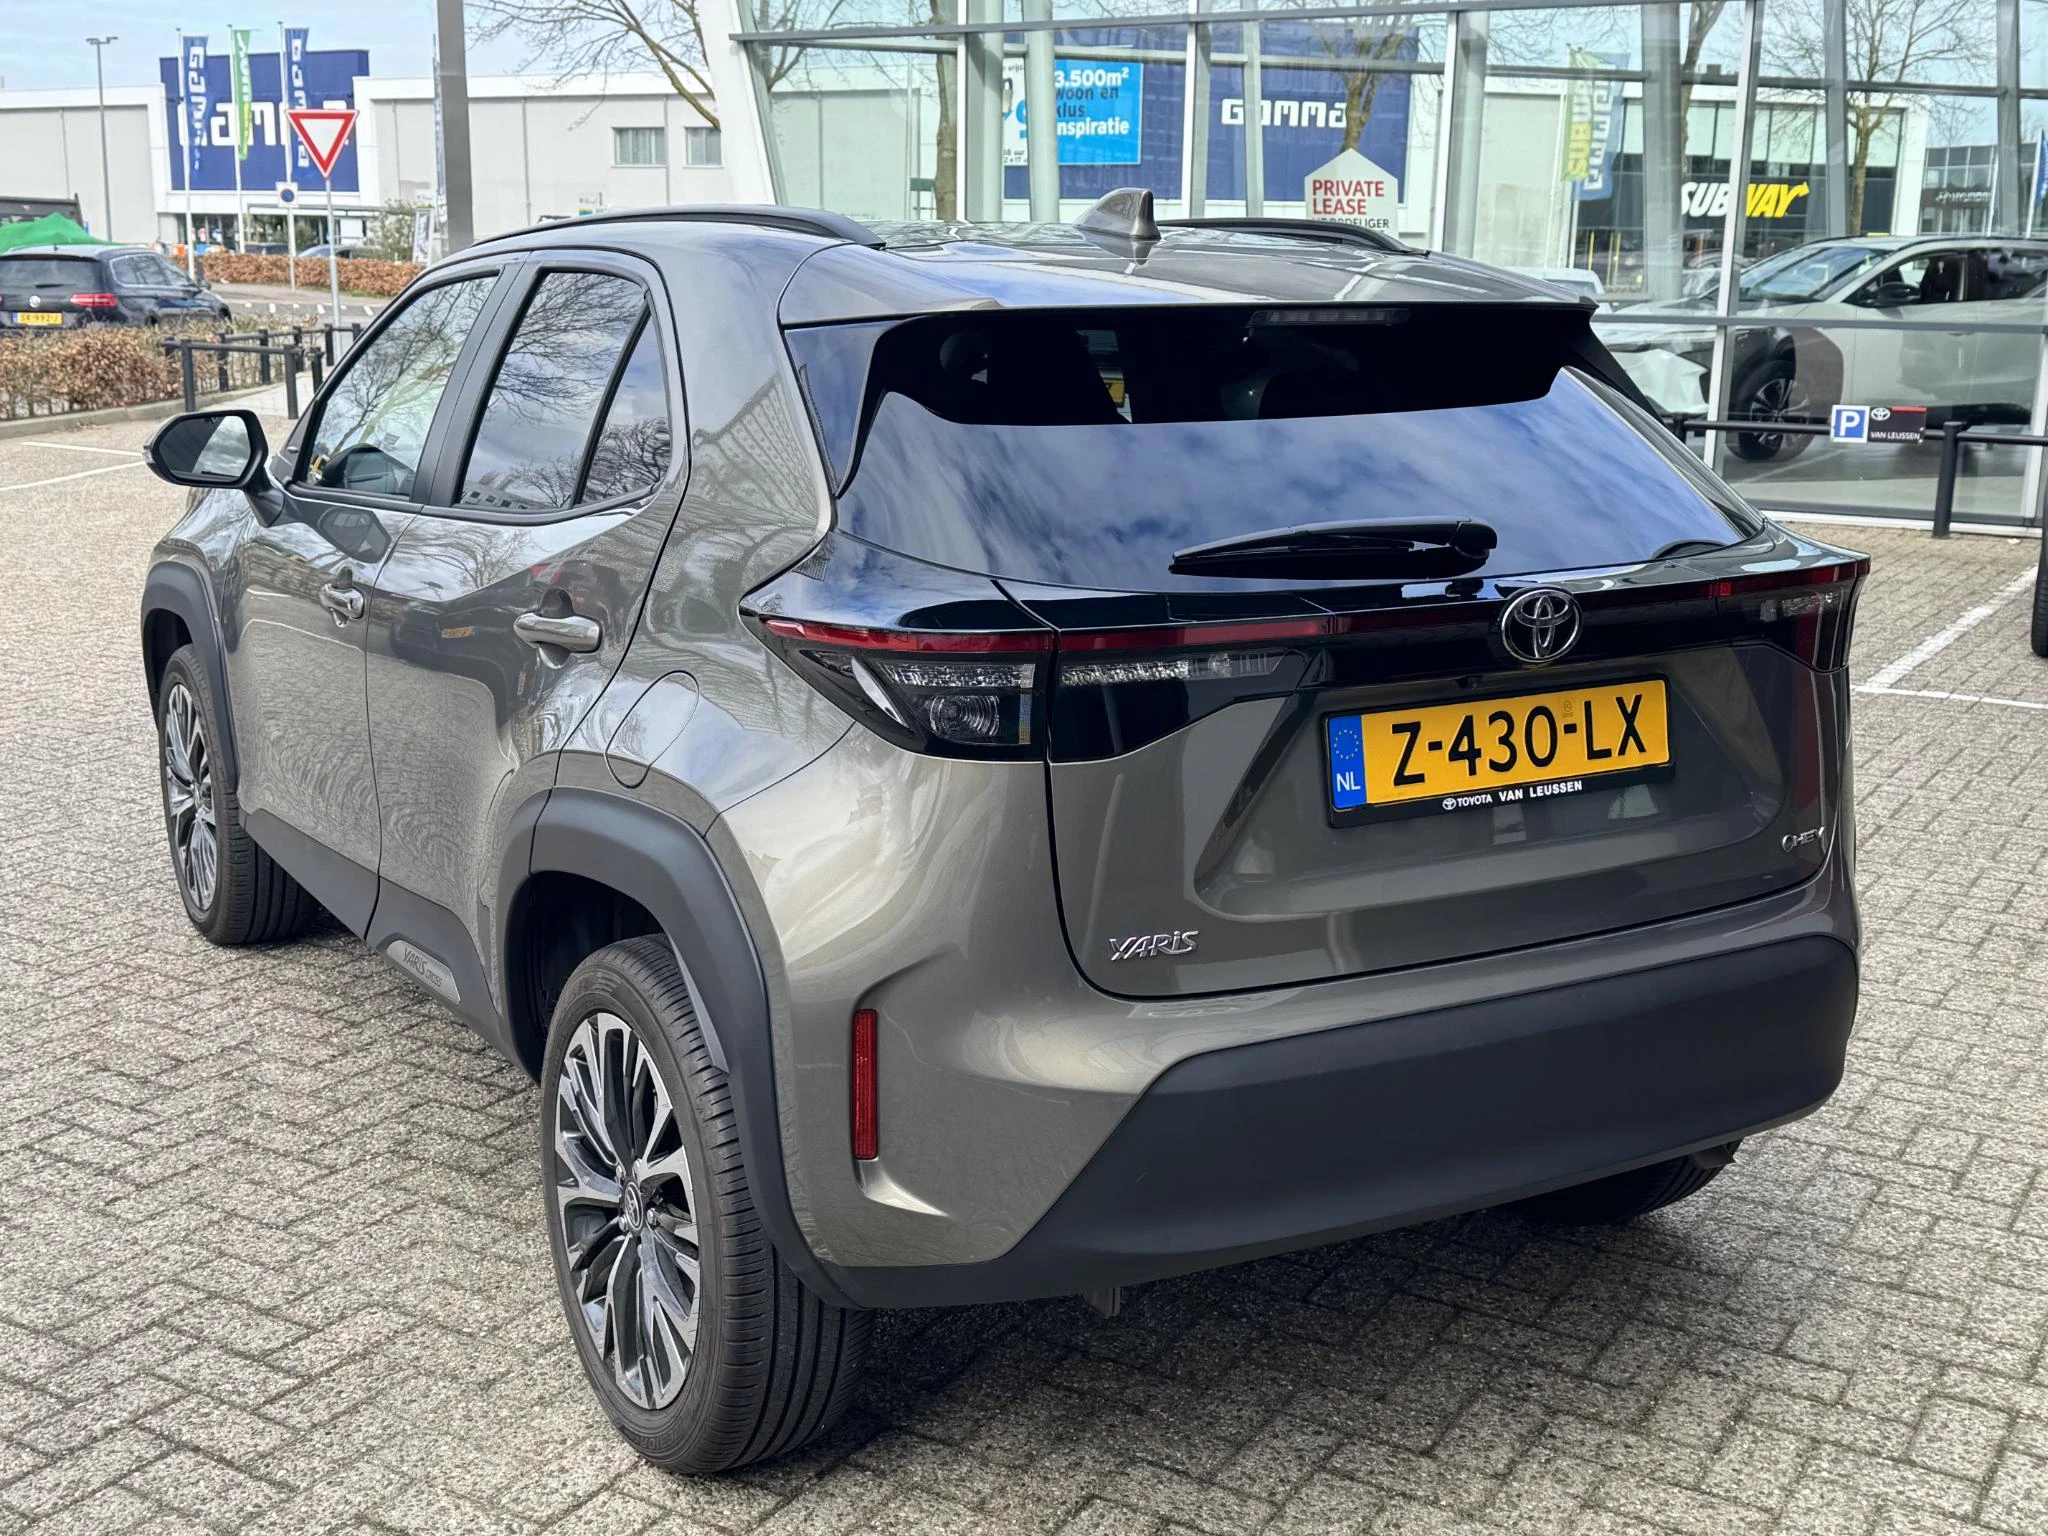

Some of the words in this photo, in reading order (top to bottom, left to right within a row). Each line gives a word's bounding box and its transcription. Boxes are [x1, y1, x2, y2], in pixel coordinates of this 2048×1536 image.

[1100, 86, 1120, 100] en
[1056, 117, 1130, 139] nspiratie
[1312, 179, 1385, 197] PRIVATE
[1681, 181, 1810, 218] SUBWAY
[1312, 198, 1368, 216] LEASE
[1839, 410, 1860, 437] P
[1870, 431, 1886, 440] VAN
[1887, 431, 1920, 440] LEUSSEN
[1391, 693, 1648, 788] Z-430-LX
[1336, 771, 1361, 793] NL
[1457, 794, 1493, 808] TOYOTA
[1498, 788, 1524, 802] VAN
[1529, 780, 1583, 798] LEUSSEN
[1109, 930, 1199, 961] YARIS
[403, 946, 428, 976] YARIS
